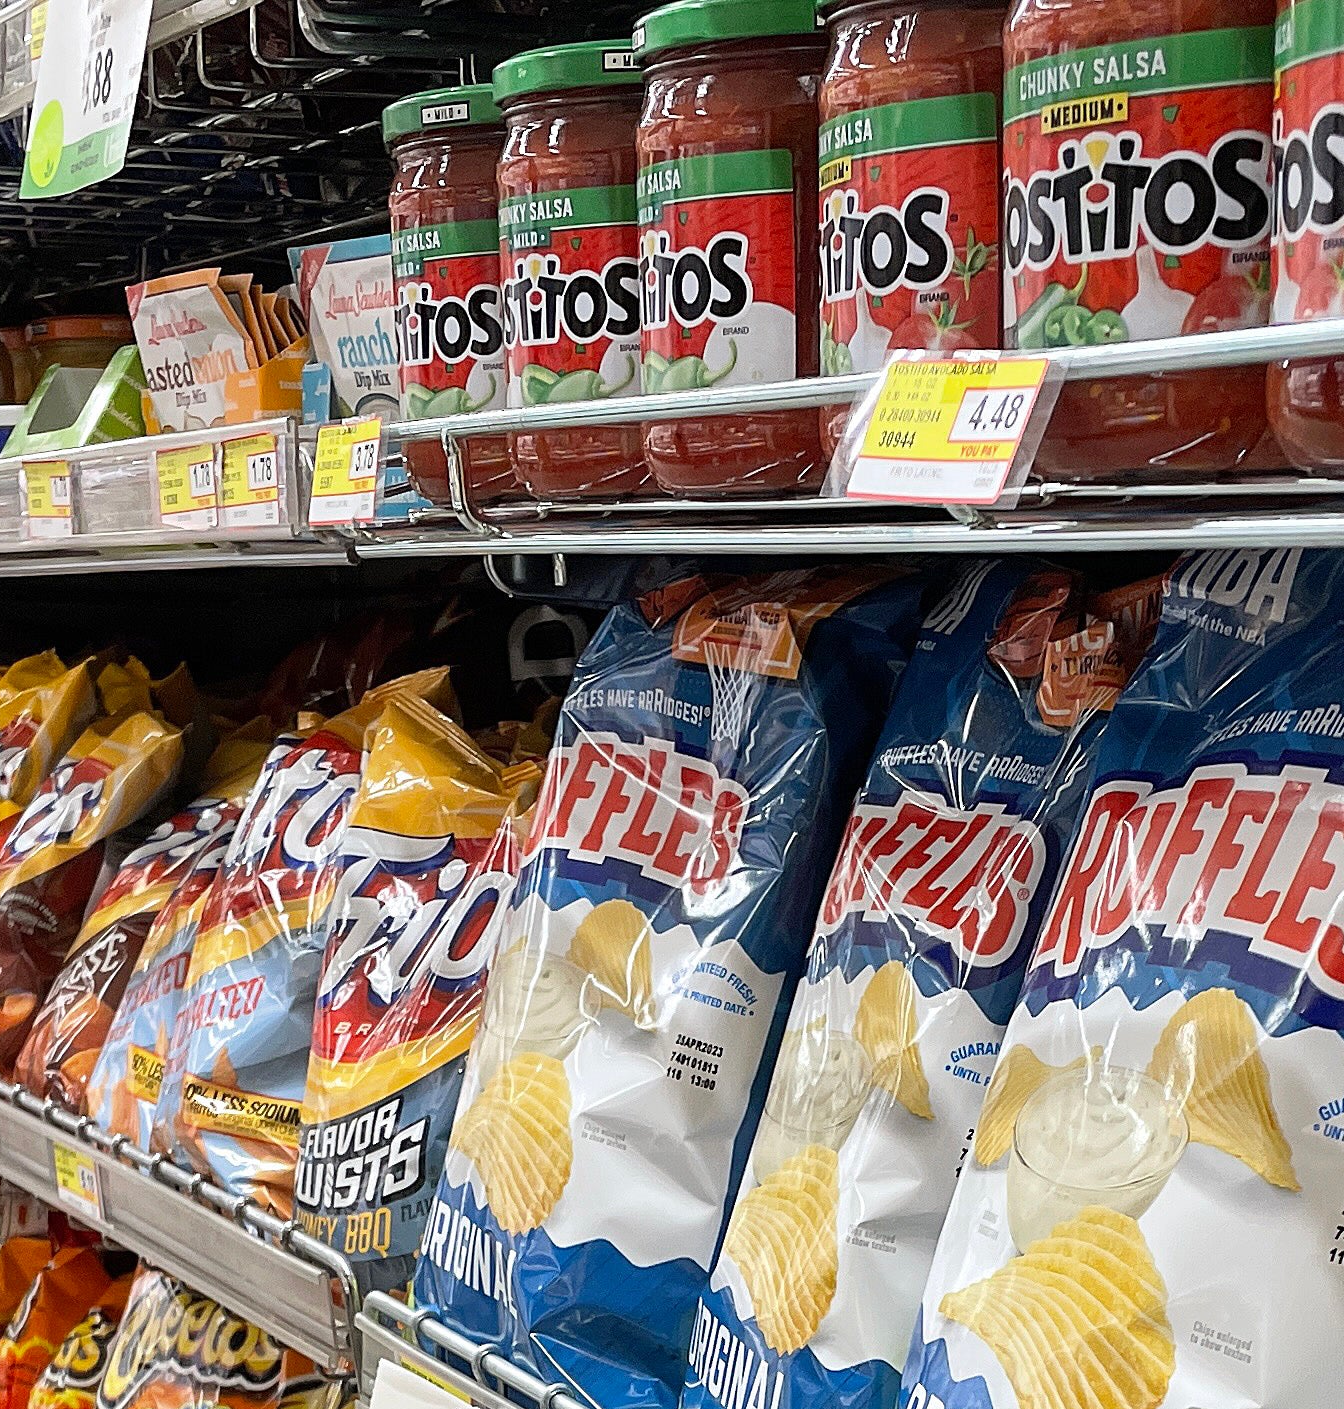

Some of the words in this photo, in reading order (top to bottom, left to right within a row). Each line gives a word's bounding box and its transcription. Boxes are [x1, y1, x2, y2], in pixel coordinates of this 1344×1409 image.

[1019, 57, 1084, 101] CHUNKY
[1093, 49, 1167, 85] SALSA
[433, 107, 454, 120] MILD
[1050, 98, 1114, 129] MEDIUM
[834, 119, 873, 149] SALSA
[647, 169, 681, 192] SALSA
[529, 197, 573, 220] SALSA
[407, 231, 441, 251] SALSA
[512, 231, 539, 248] MILD
[919, 291, 949, 303] BRAND
[337, 317, 398, 368] ranch
[722, 326, 749, 336] BRAND
[620, 343, 640, 352] BRAN
[146, 356, 195, 392] asted
[353, 371, 370, 388] Dip
[371, 369, 391, 386] Mix
[968, 394, 1025, 432] 4.48
[878, 430, 916, 448] 30944
[961, 445, 978, 457] YOU
[980, 445, 1000, 458] PAY
[251, 456, 272, 482] 1.78
[355, 444, 375, 471] 3.78
[607, 689, 635, 709] HAVE
[1252, 711, 1293, 737] HAVE
[727, 973, 759, 1007] FRESH
[689, 991, 723, 1009] PRINTED
[723, 1001, 748, 1017] DATE
[950, 1042, 1001, 1063] GUARAN
[953, 1065, 982, 1085] UNTIL
[213, 1090, 248, 1112] LESS
[247, 1101, 301, 1125] SODIUM
[304, 1099, 402, 1158] FLAVOR
[296, 1123, 426, 1209] WISTS
[344, 1207, 392, 1257] BBQ
